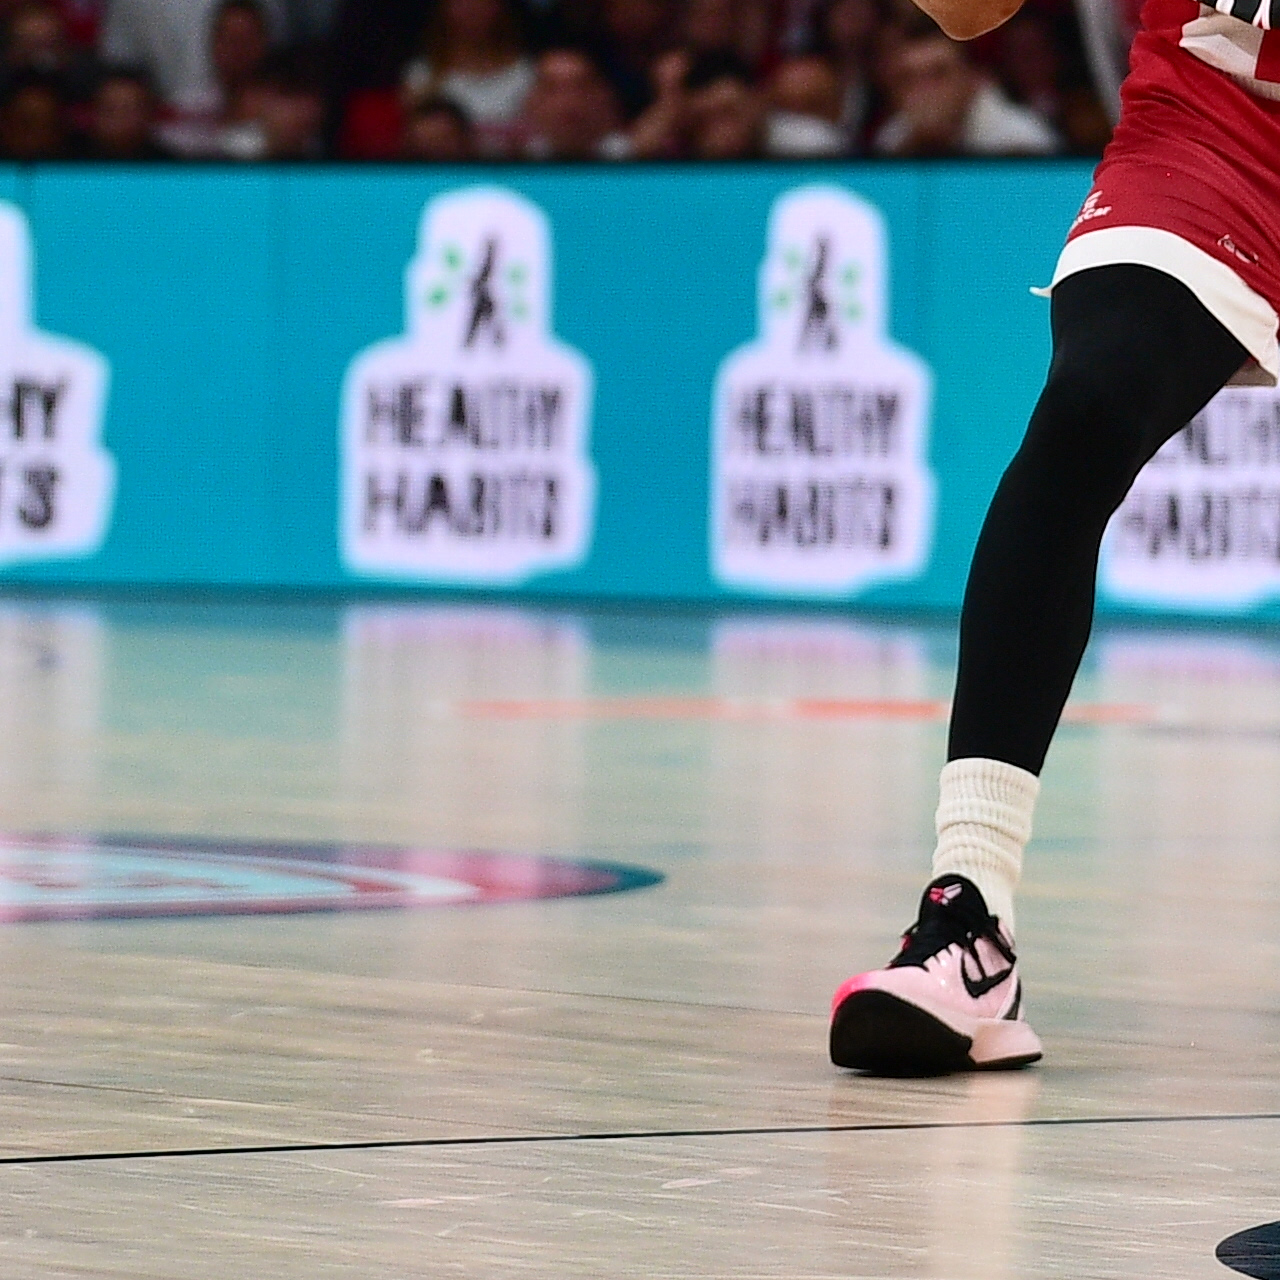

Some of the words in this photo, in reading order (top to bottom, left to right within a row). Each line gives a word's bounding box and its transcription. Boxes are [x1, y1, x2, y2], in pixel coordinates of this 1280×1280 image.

[363, 378, 562, 451] HEALTHY
[734, 385, 900, 456] HEALTHY
[362, 470, 560, 542] HABITS
